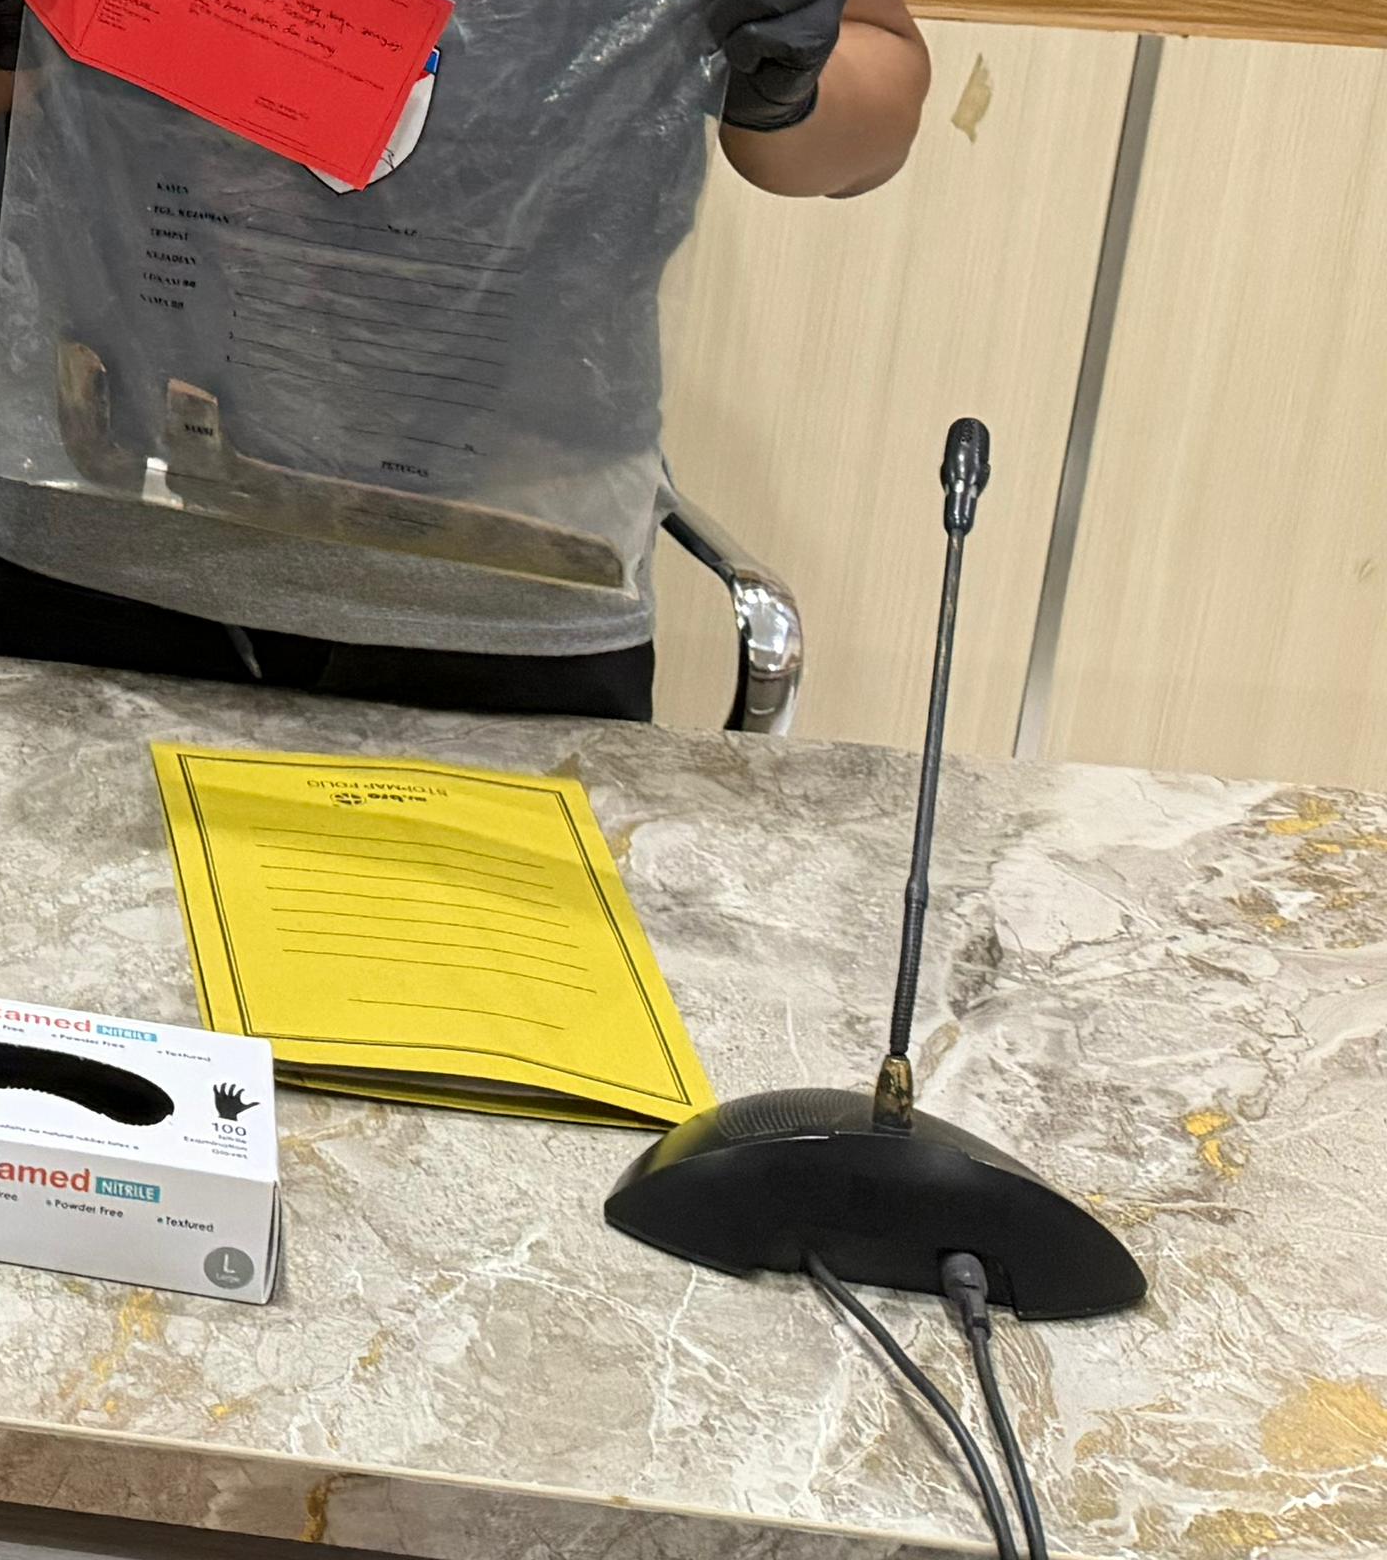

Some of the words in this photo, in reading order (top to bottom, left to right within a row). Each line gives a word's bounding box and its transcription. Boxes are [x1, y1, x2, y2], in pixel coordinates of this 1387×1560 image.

[211, 1121, 248, 1138] 100
[101, 1180, 156, 1201] NITRILE
[55, 1198, 96, 1215] Powder
[99, 1206, 124, 1219] Free
[165, 1216, 215, 1233] Textured
[223, 1253, 236, 1275] L
